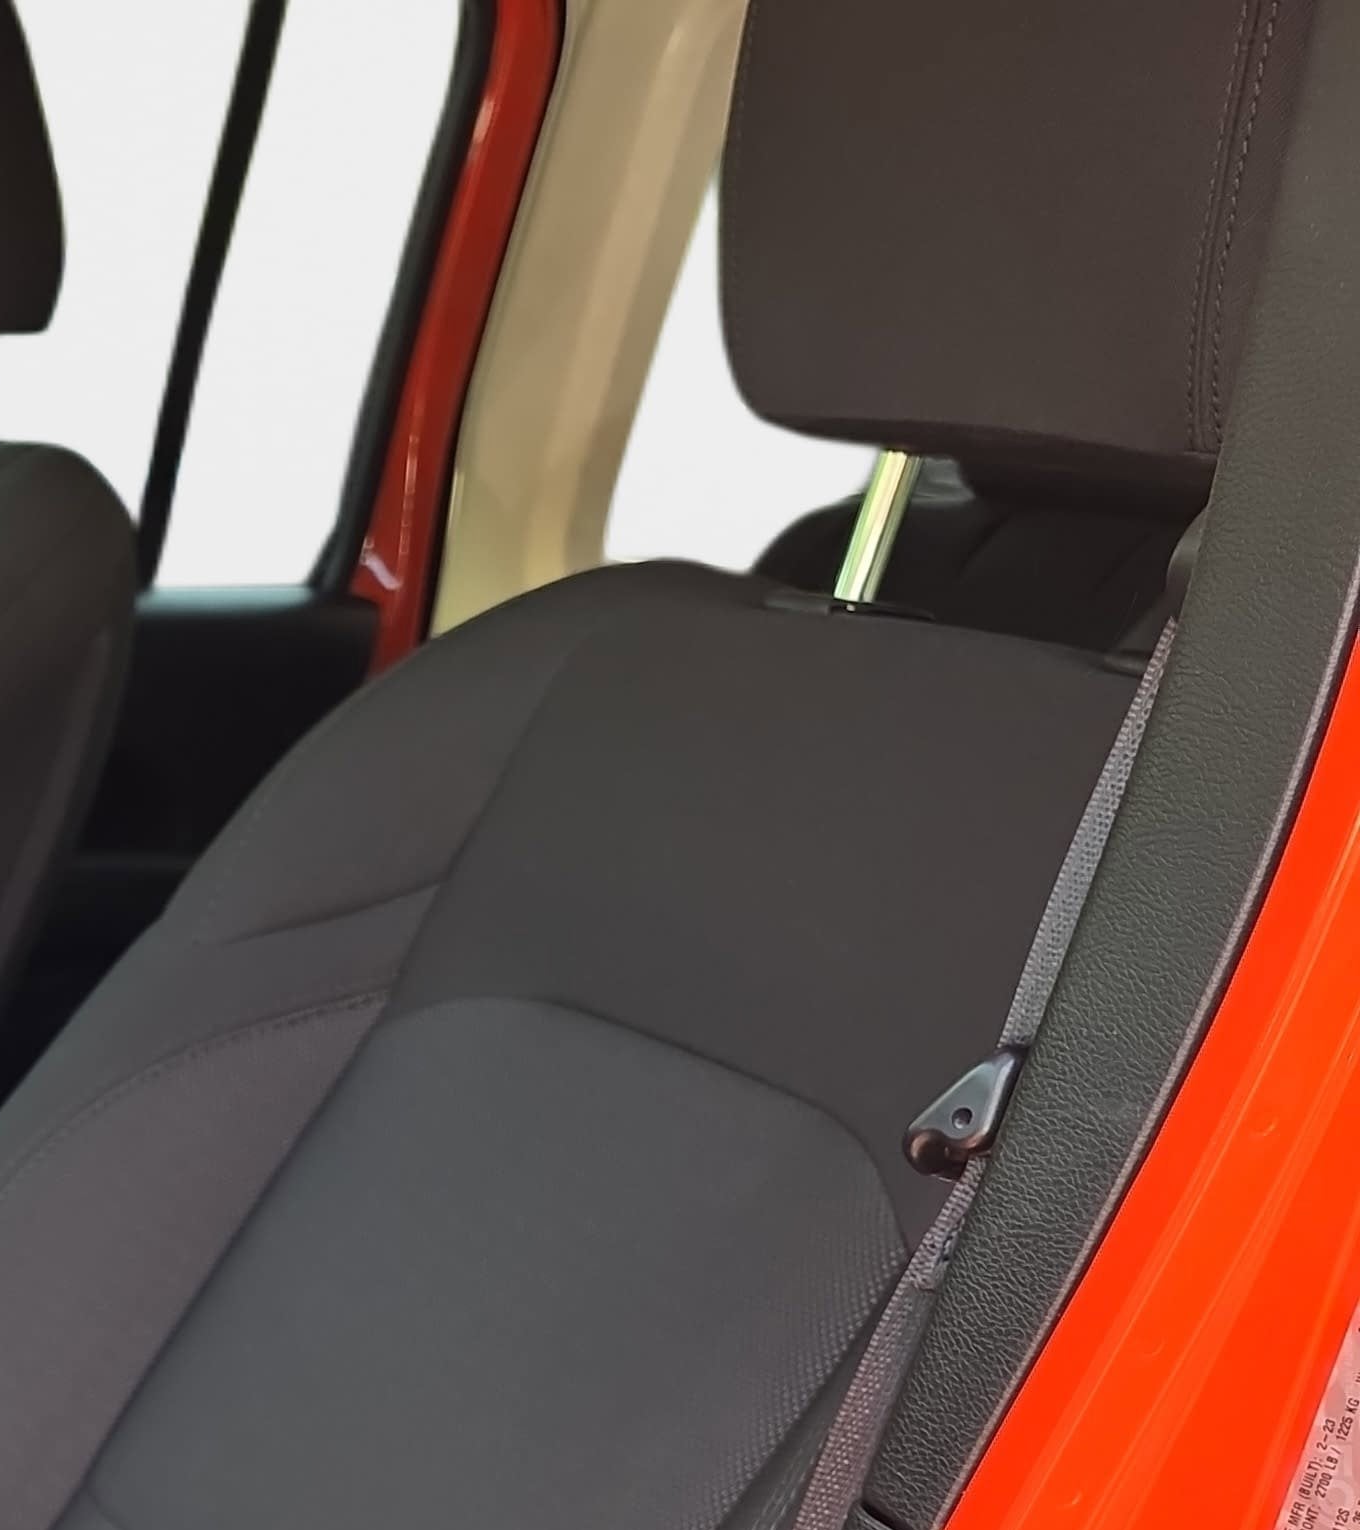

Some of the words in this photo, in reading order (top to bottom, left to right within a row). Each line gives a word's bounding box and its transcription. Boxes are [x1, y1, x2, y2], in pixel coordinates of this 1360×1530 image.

[1314, 1472, 1333, 1499] 2700
[1335, 1416, 1353, 1441] 1225
[1287, 1501, 1305, 1526] MFR
